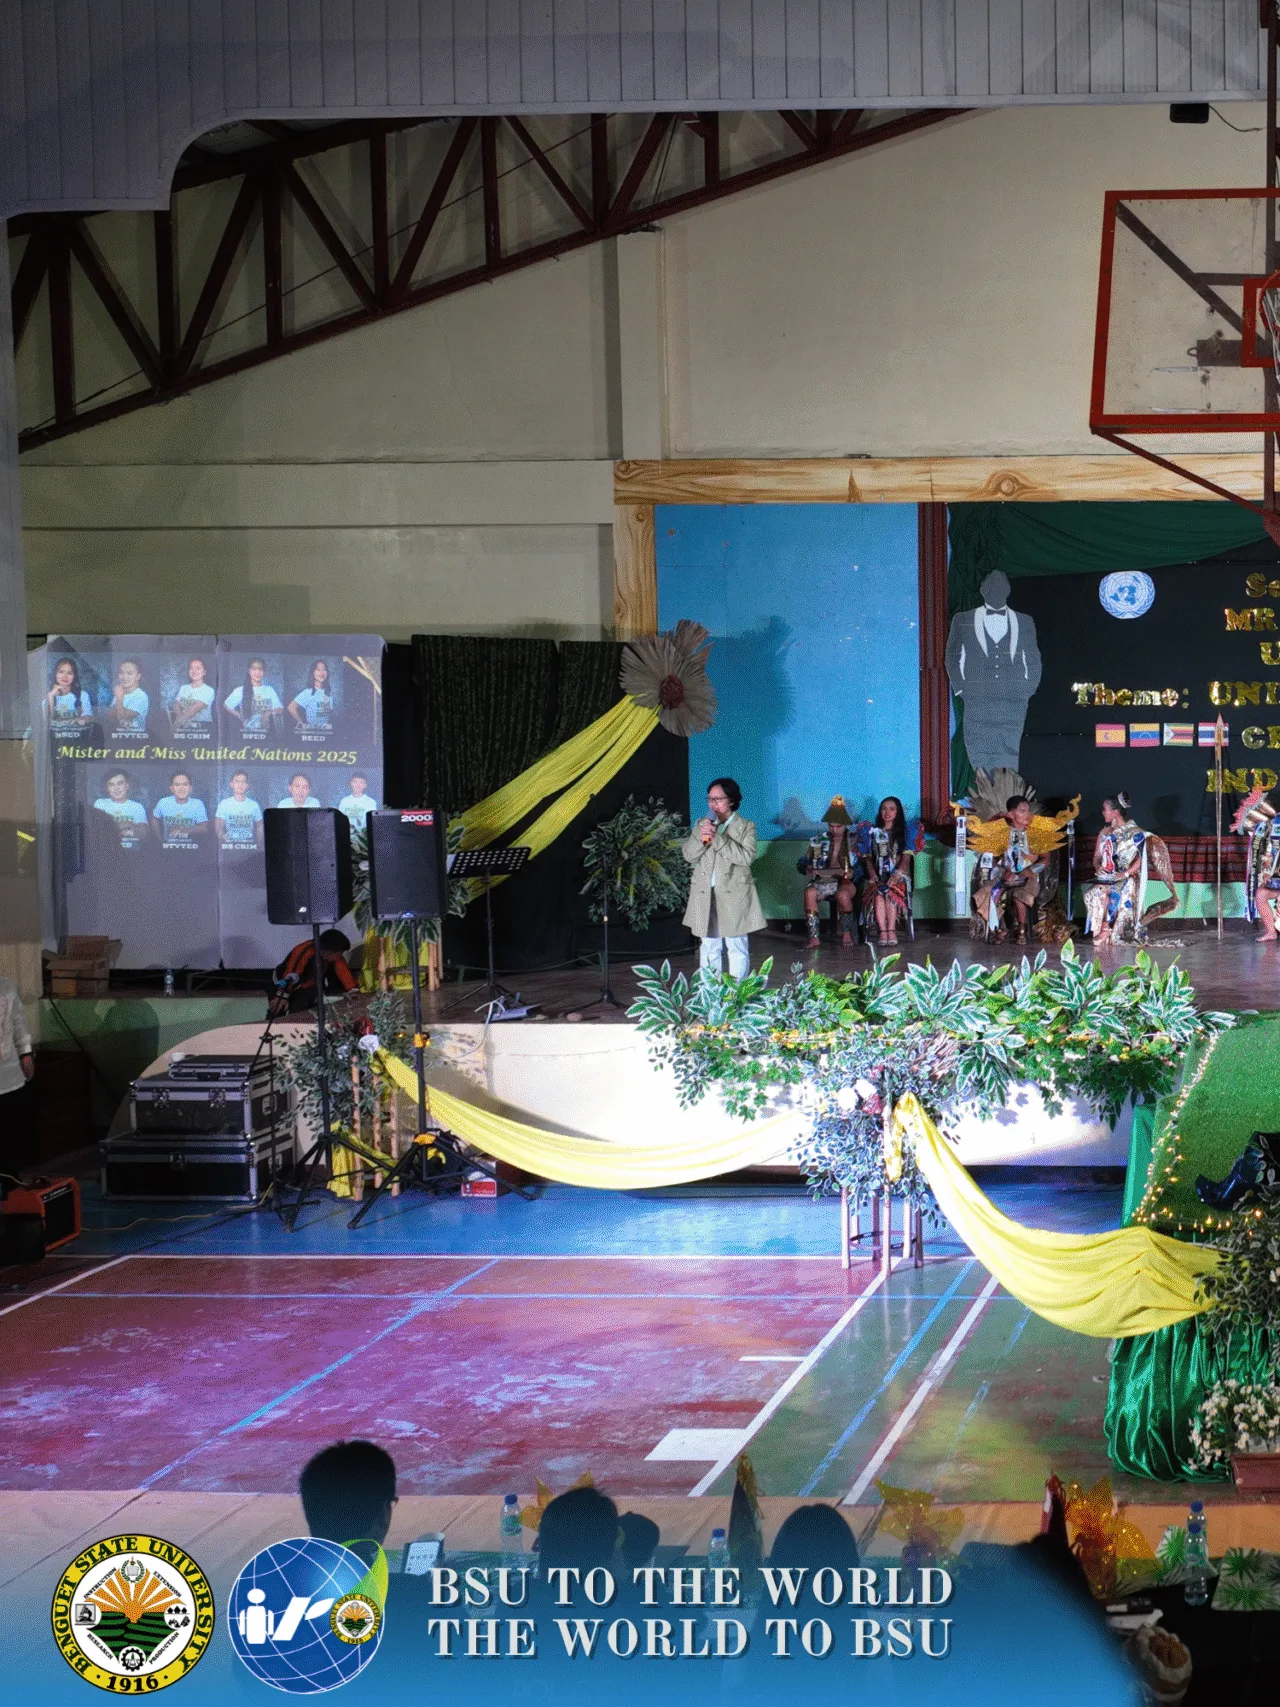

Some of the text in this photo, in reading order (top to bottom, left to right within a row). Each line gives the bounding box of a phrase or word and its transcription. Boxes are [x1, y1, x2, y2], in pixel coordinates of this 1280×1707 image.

[1223, 607, 1279, 632] MR
[1071, 681, 1190, 709] Theme:
[56, 744, 358, 765] Mister and Miss United Nations 2025
